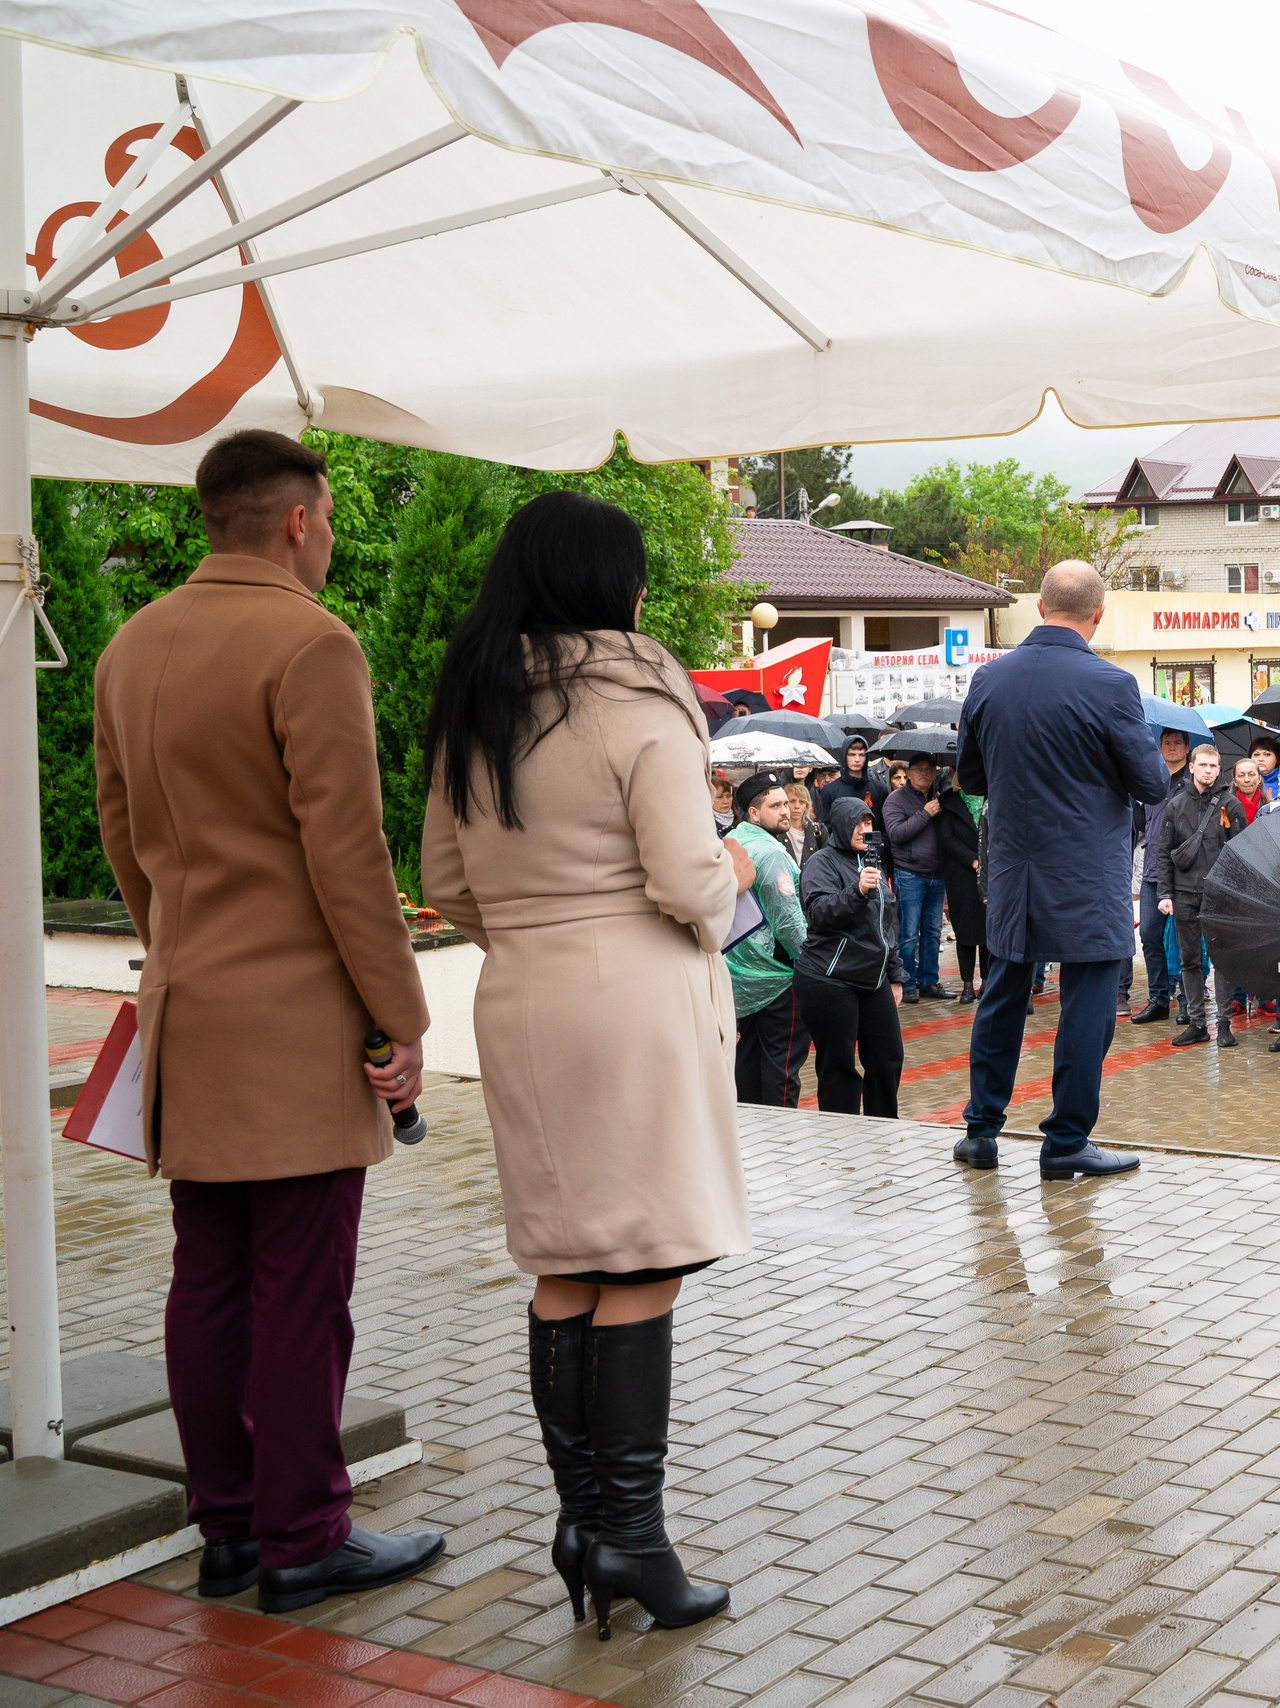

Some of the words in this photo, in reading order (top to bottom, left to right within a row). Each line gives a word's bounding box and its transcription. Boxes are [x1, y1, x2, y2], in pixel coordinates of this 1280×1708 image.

[1153, 611, 1240, 630] КУЛИНАРИЯ
[874, 654, 914, 667] ИСТОРИЯ
[918, 654, 939, 666] СЕЛА
